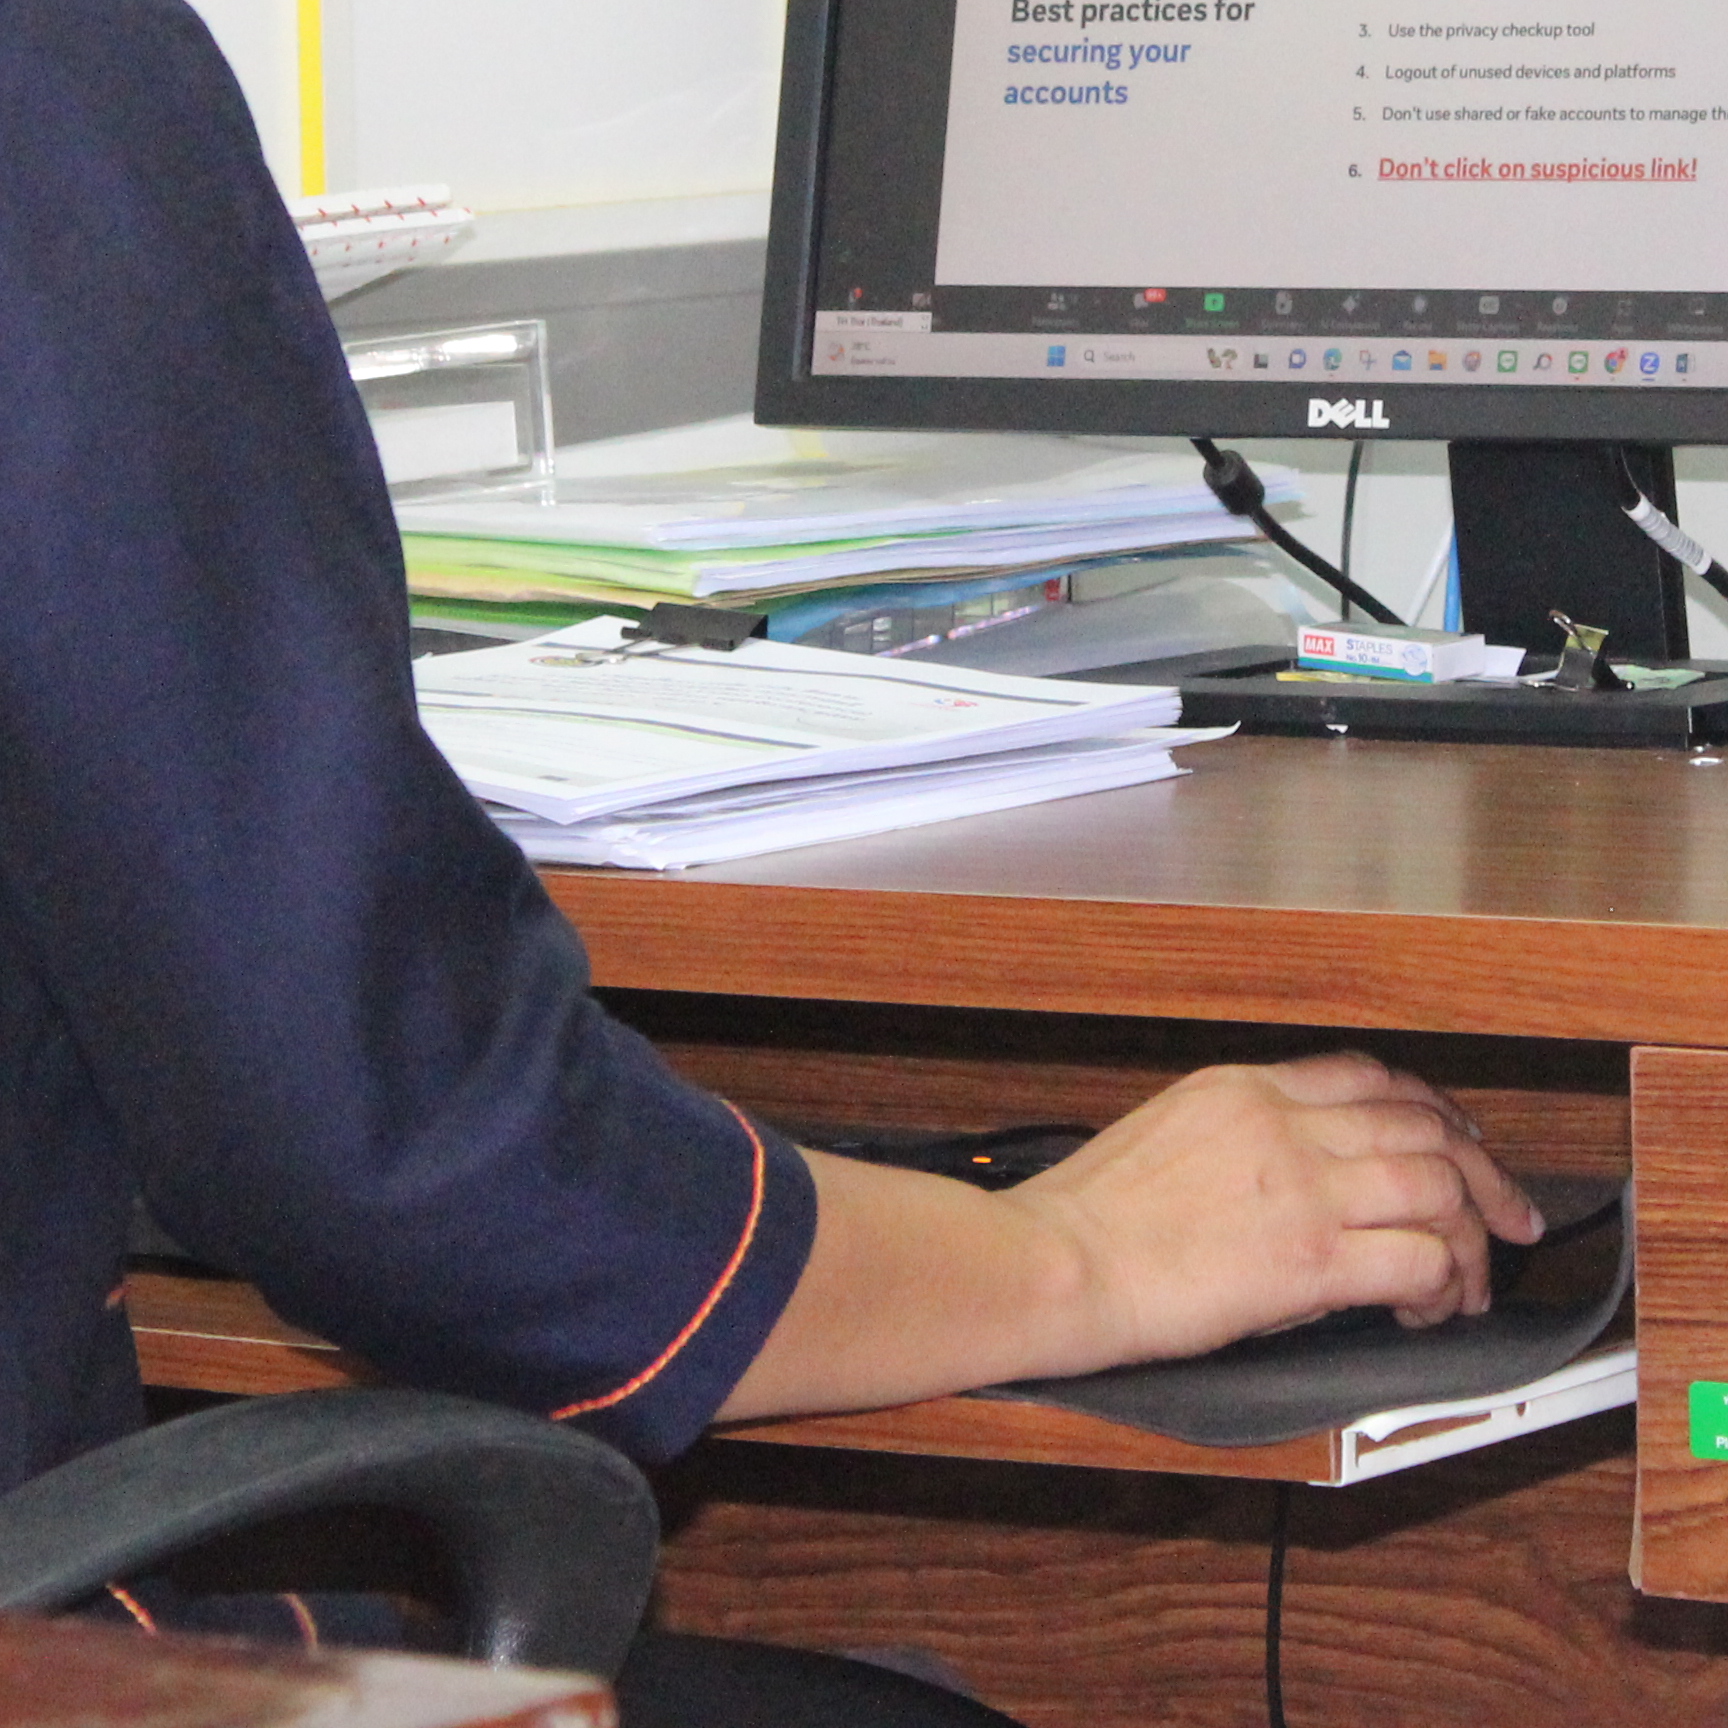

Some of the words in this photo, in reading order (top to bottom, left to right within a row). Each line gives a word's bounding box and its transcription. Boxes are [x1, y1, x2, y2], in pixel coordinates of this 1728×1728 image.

[1359, 24, 1371, 38] 3.
[1388, 23, 1416, 38] Use
[1419, 23, 1443, 37] the
[1446, 23, 1498, 41] privacy
[1501, 22, 1563, 40] checkup
[1567, 22, 1595, 37] tool
[1007, 37, 1123, 70] securing
[1129, 42, 1192, 70] your
[1356, 65, 1369, 80] 4.
[1385, 65, 1437, 82] Logout
[1441, 64, 1457, 79] of
[1459, 64, 1512, 79] unused
[1515, 64, 1570, 79] devices
[1573, 64, 1601, 79] and
[1604, 63, 1676, 81] platforms
[1003, 81, 1129, 105] accounts
[1352, 107, 1366, 122] 5.
[1382, 106, 1422, 122] Don't
[1425, 110, 1451, 122] use
[1454, 106, 1503, 122] shared
[1506, 110, 1521, 121] or
[1524, 106, 1556, 121] fake
[1559, 107, 1626, 121] accounts
[1629, 108, 1645, 121] to
[1648, 109, 1707, 124] manage
[1348, 164, 1362, 178] 6.
[1378, 158, 1439, 179] Don't
[1444, 158, 1492, 179] click
[1498, 162, 1525, 179] on
[1530, 158, 1645, 183] suspicious
[1651, 158, 1697, 179] link!
[1307, 397, 1392, 430] DELL
[1304, 636, 1334, 654] MAX
[1346, 638, 1393, 655] STAPLES
